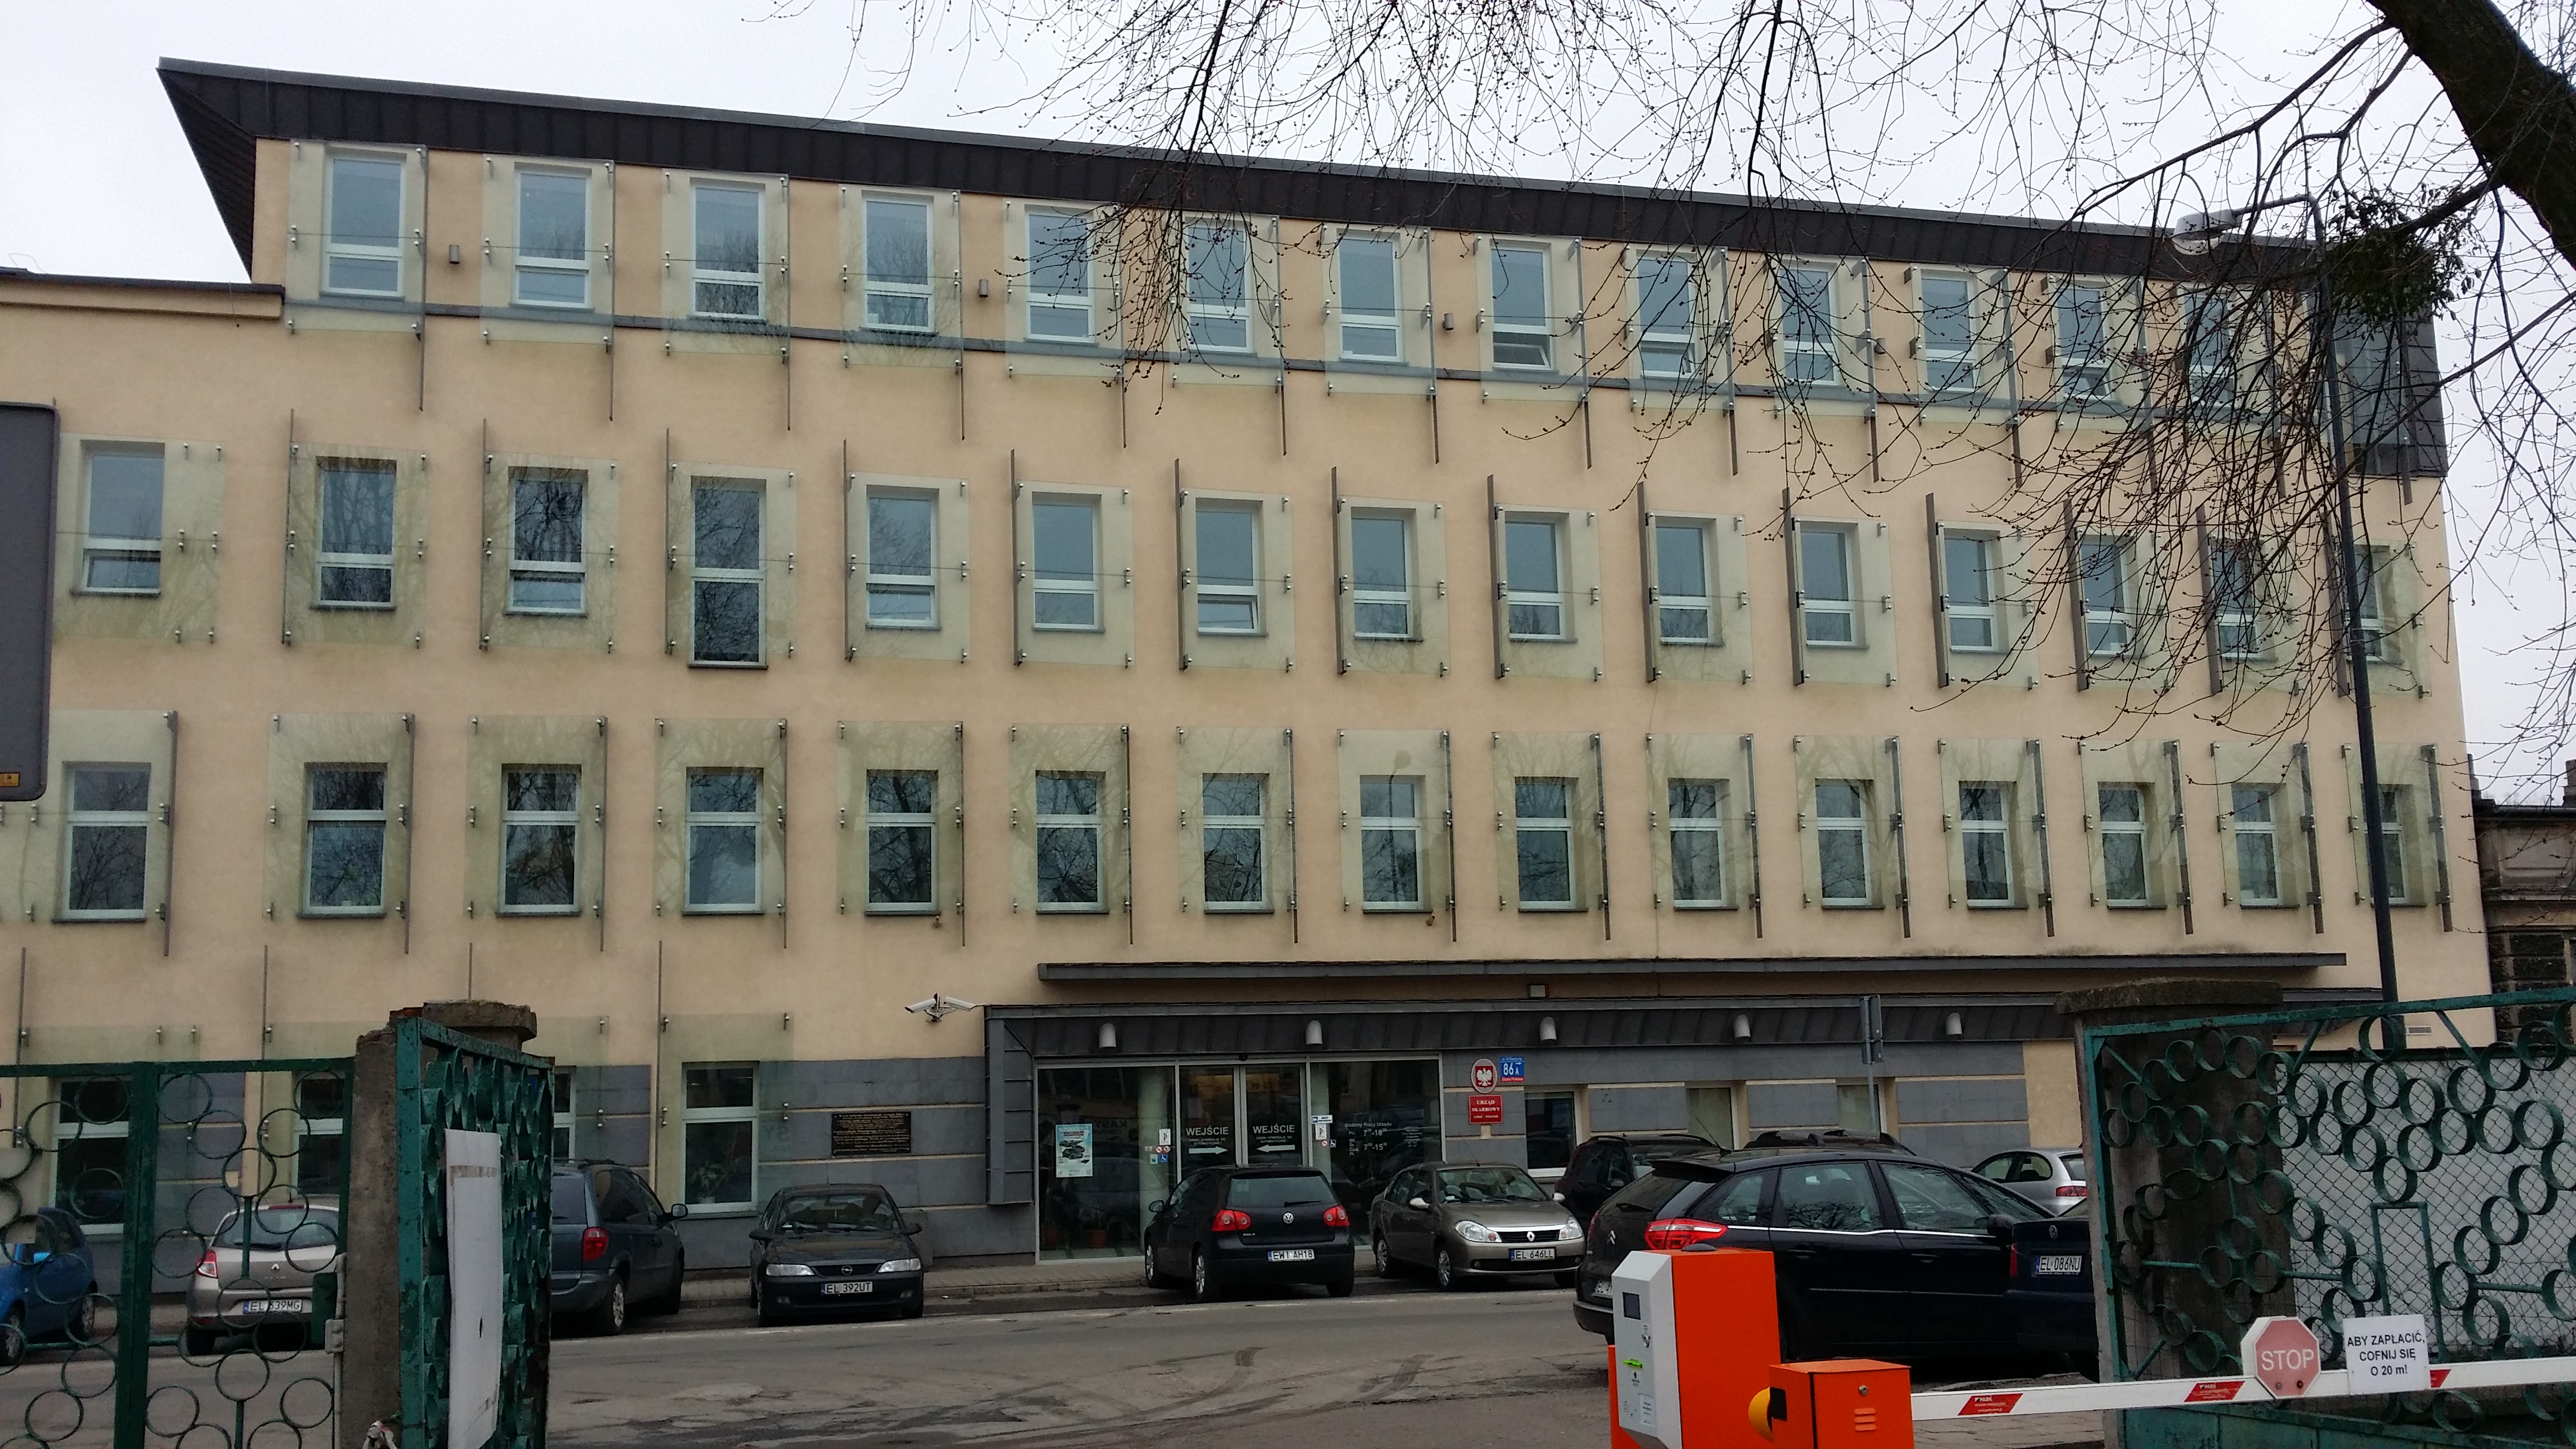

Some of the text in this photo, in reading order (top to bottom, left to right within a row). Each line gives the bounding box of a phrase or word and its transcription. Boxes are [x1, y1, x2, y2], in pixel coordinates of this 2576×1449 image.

[1186, 1125, 1229, 1136] WEJŚCIE
[1252, 1123, 1295, 1134] WEJŚCIE
[1273, 1250, 1313, 1259] EWI AH18
[1516, 1250, 1553, 1259] EL 646LL
[2040, 1257, 2081, 1271] EL 086NU
[826, 1282, 871, 1293] EL 392UT
[250, 1300, 300, 1310] EL 639MG
[2347, 1330, 2425, 1347] ABY ZAPŁACIĆ,
[2261, 1349, 2314, 1371] STOP
[2359, 1348, 2416, 1362] COFNIJ SIĘ
[2371, 1364, 2408, 1376] O 20 m!
